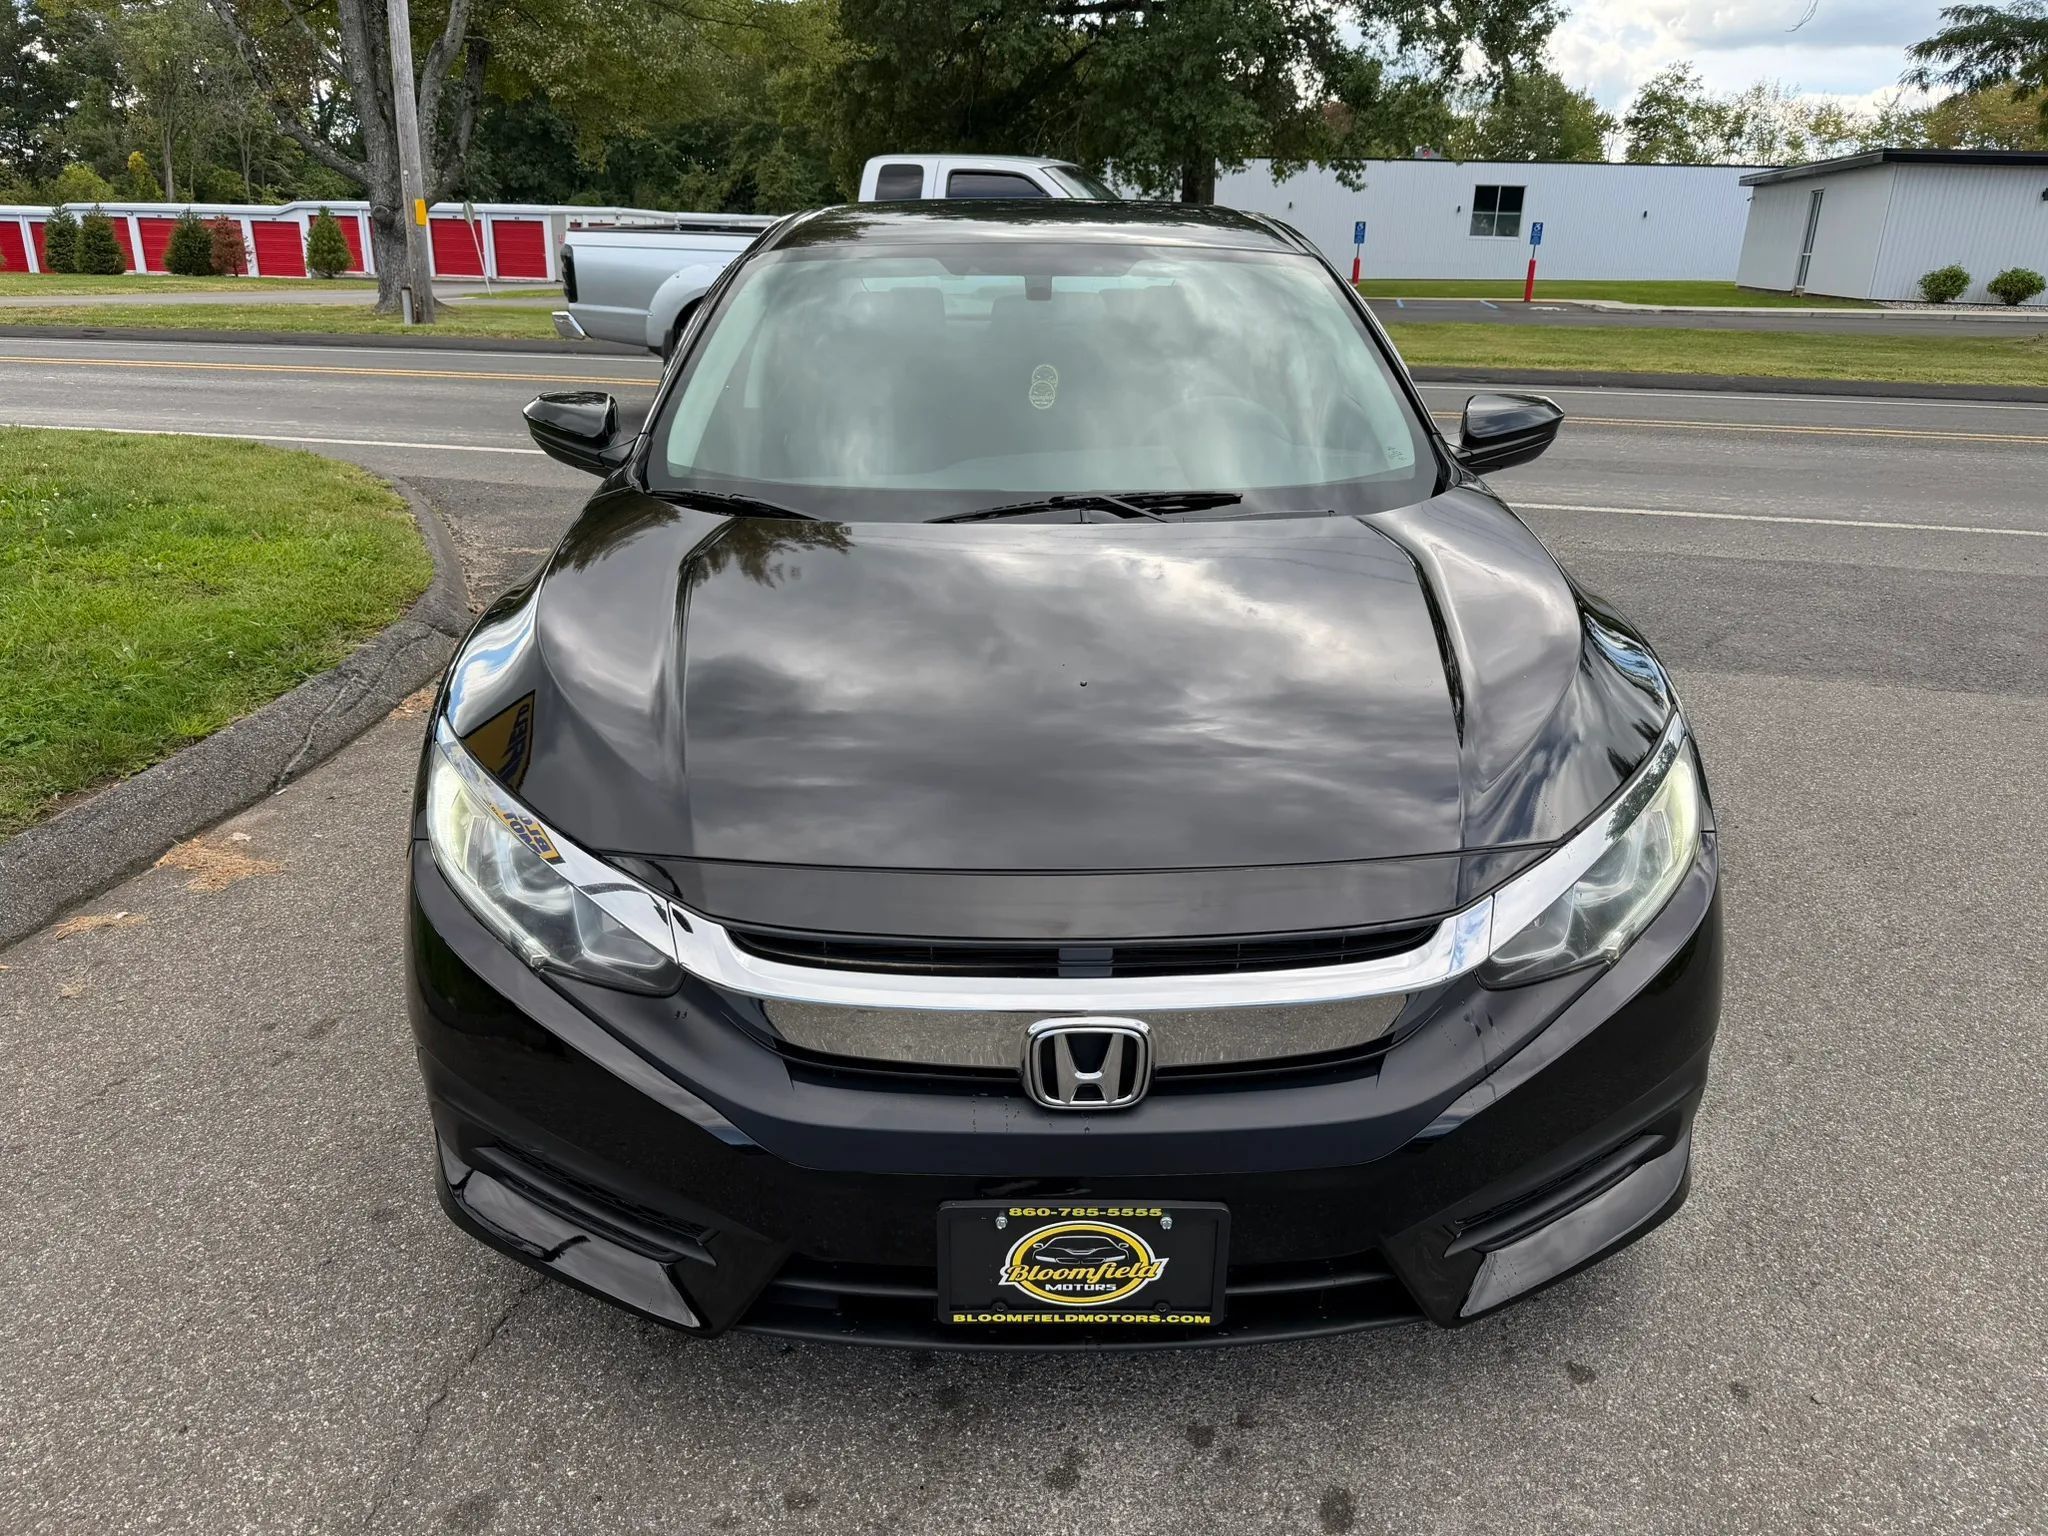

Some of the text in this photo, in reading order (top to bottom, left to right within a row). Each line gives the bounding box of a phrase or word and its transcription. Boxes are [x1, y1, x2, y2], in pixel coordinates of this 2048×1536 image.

[1009, 1208, 1163, 1217] 860-785-5555
[1006, 1262, 1160, 1283] Bloomfield
[952, 1314, 1211, 1323] BLOOMFIELDMOTORS.COM
